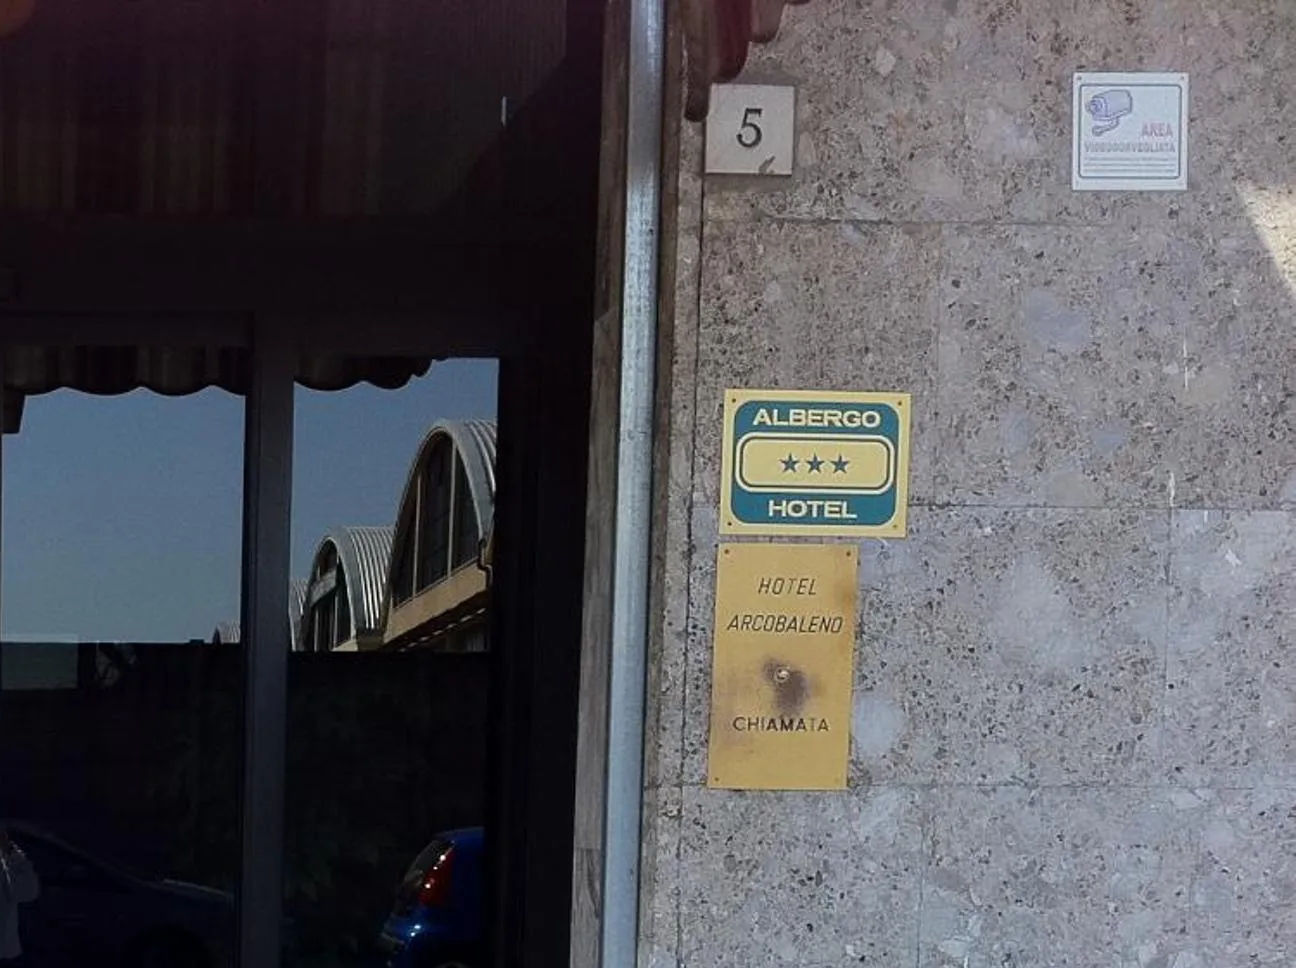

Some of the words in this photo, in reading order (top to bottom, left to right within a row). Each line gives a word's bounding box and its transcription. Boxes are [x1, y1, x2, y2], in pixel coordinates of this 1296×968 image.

[736, 107, 763, 148] 5
[1142, 123, 1173, 137] AREA
[752, 408, 882, 428] ALBERGO
[768, 499, 858, 519] HOTEL
[758, 577, 818, 596] HOTEL
[726, 614, 844, 634] ARCOBALENO
[732, 716, 830, 733] CHIAMATA
